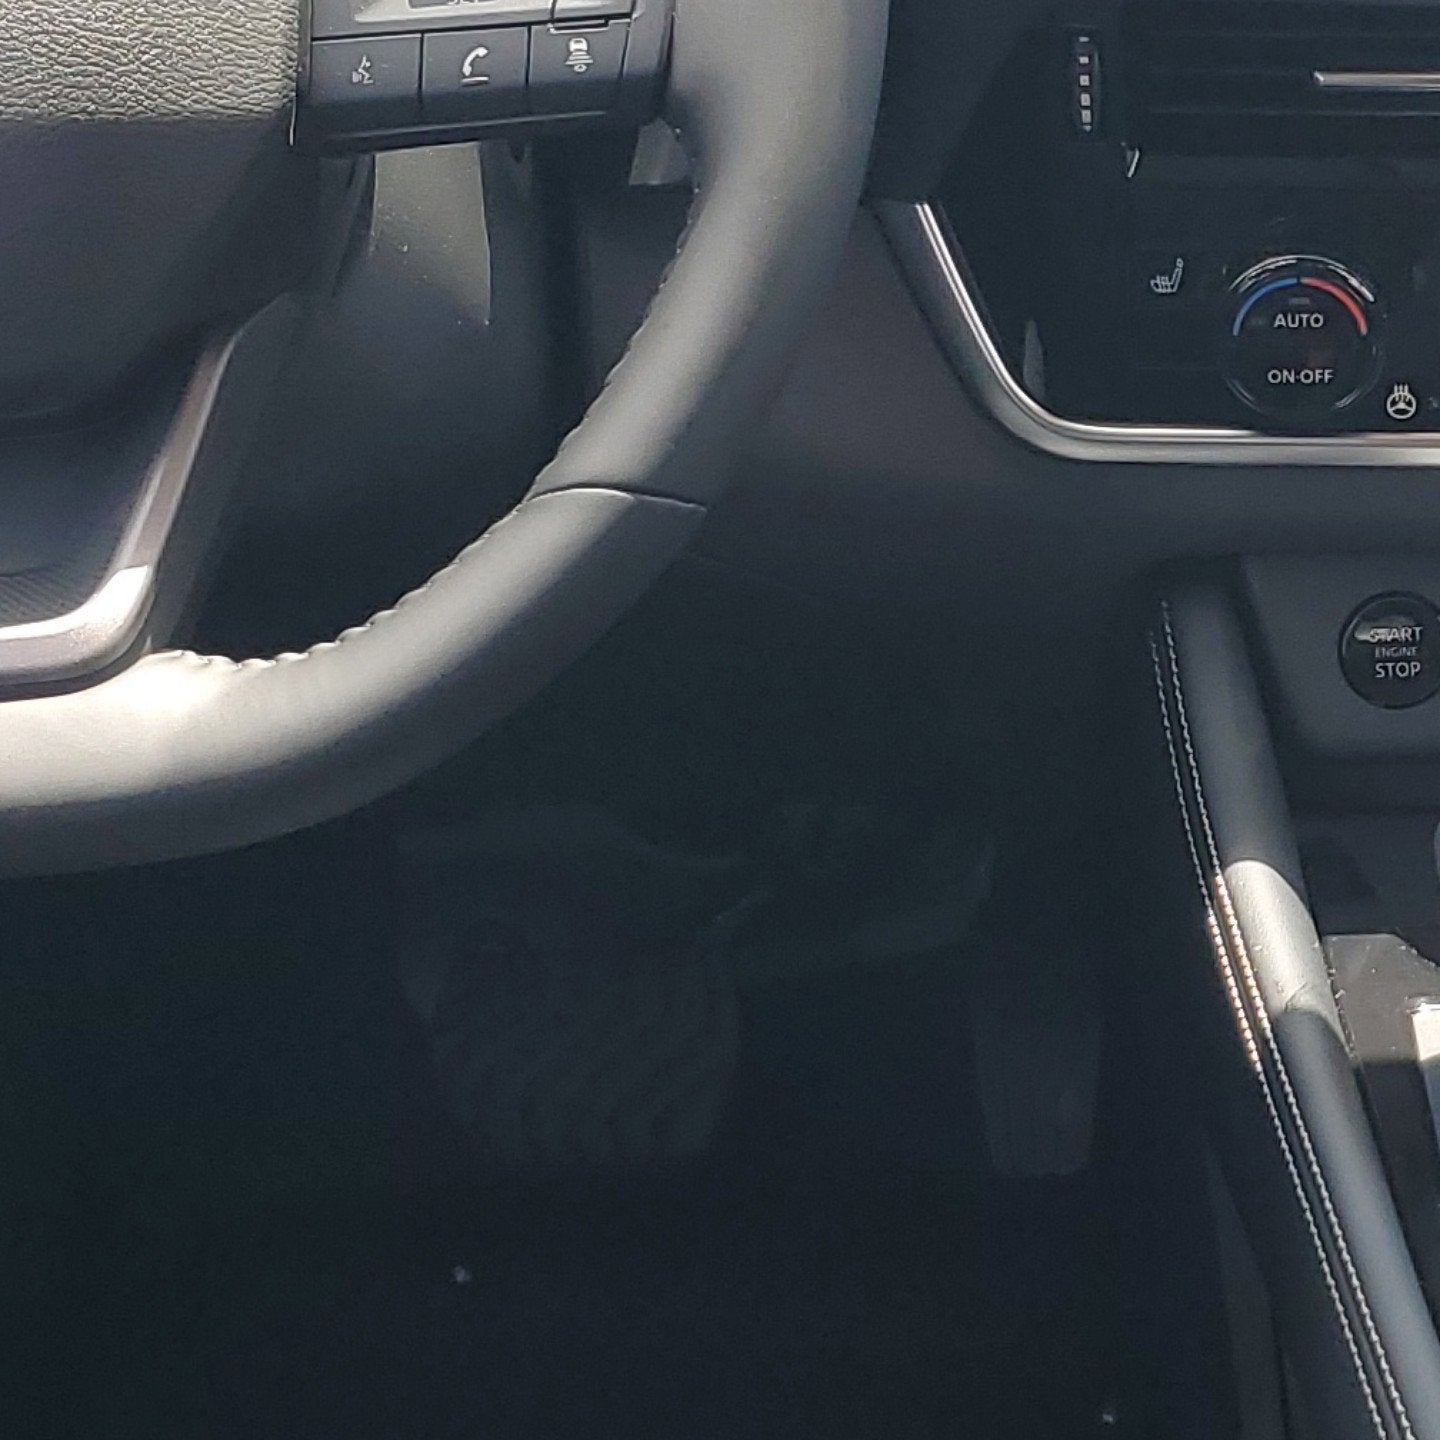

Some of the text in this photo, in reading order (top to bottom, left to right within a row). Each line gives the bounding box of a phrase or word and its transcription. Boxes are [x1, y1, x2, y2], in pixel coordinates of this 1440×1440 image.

[1273, 313, 1324, 328] AUTO
[1369, 626, 1423, 643] START
[1375, 661, 1421, 678] STOP
